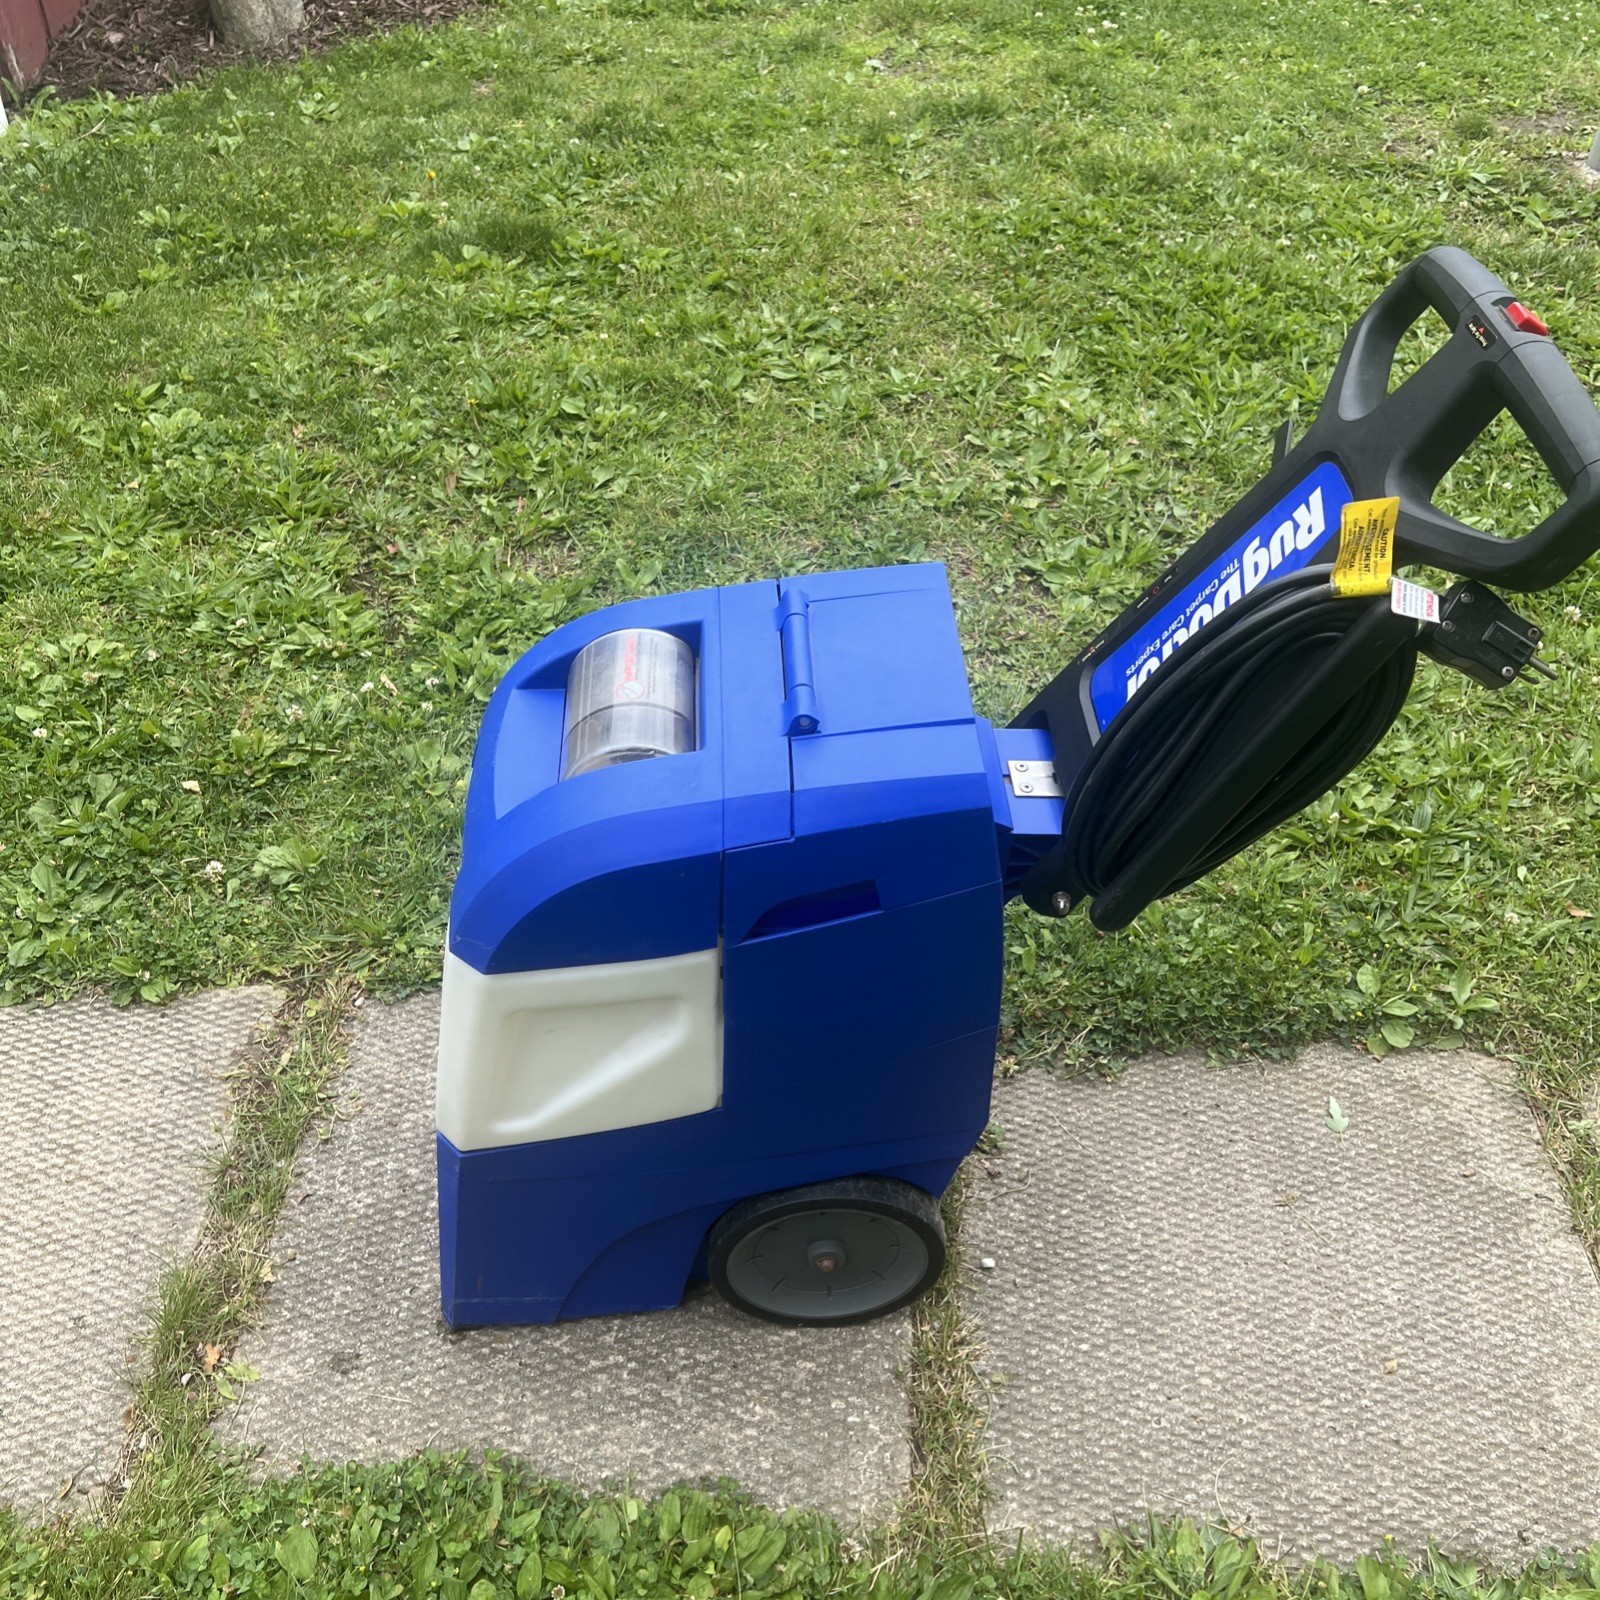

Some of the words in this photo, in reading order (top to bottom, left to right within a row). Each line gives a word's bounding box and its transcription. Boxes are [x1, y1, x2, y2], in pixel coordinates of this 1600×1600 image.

[1220, 558, 1240, 580] The
[1186, 578, 1219, 616] Carpet
[1161, 614, 1185, 640] Care
[1125, 637, 1161, 677] Experts
